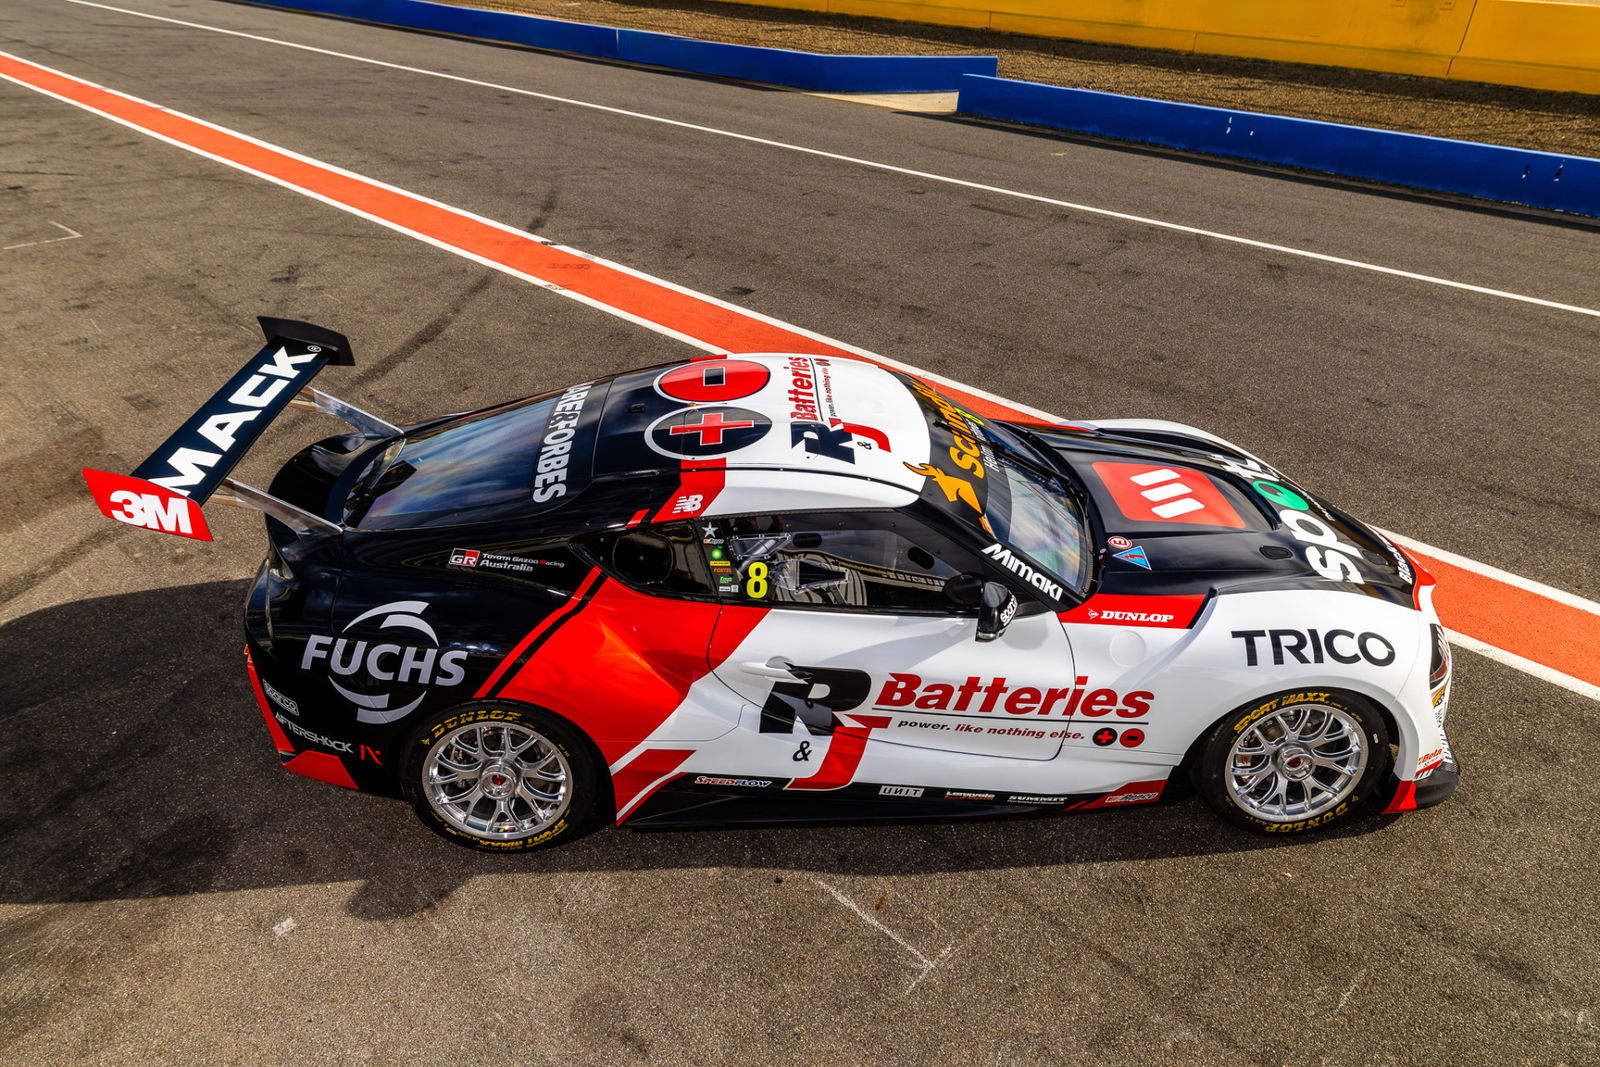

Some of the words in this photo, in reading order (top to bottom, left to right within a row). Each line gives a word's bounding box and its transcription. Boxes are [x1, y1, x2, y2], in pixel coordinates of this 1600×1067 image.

[783, 357, 818, 421] Batteries
[148, 346, 318, 496] MACK
[110, 490, 192, 534] 3M
[451, 554, 477, 566] GR
[480, 559, 534, 572] Australia
[981, 543, 1064, 602] Mimaki
[746, 561, 768, 599] 8
[1100, 610, 1174, 623] DUNLOP
[301, 634, 468, 687] FUCHS
[1231, 629, 1396, 667] TRICO
[874, 673, 1155, 719] Batteries
[1233, 698, 1280, 733] SPORT
[1281, 692, 1331, 706] MAXX
[897, 719, 950, 731] power.
[953, 723, 984, 733] like
[987, 727, 1046, 739] nothing
[1049, 730, 1085, 740] else.
[792, 741, 812, 762] &
[1264, 801, 1349, 833] DUNLOP
